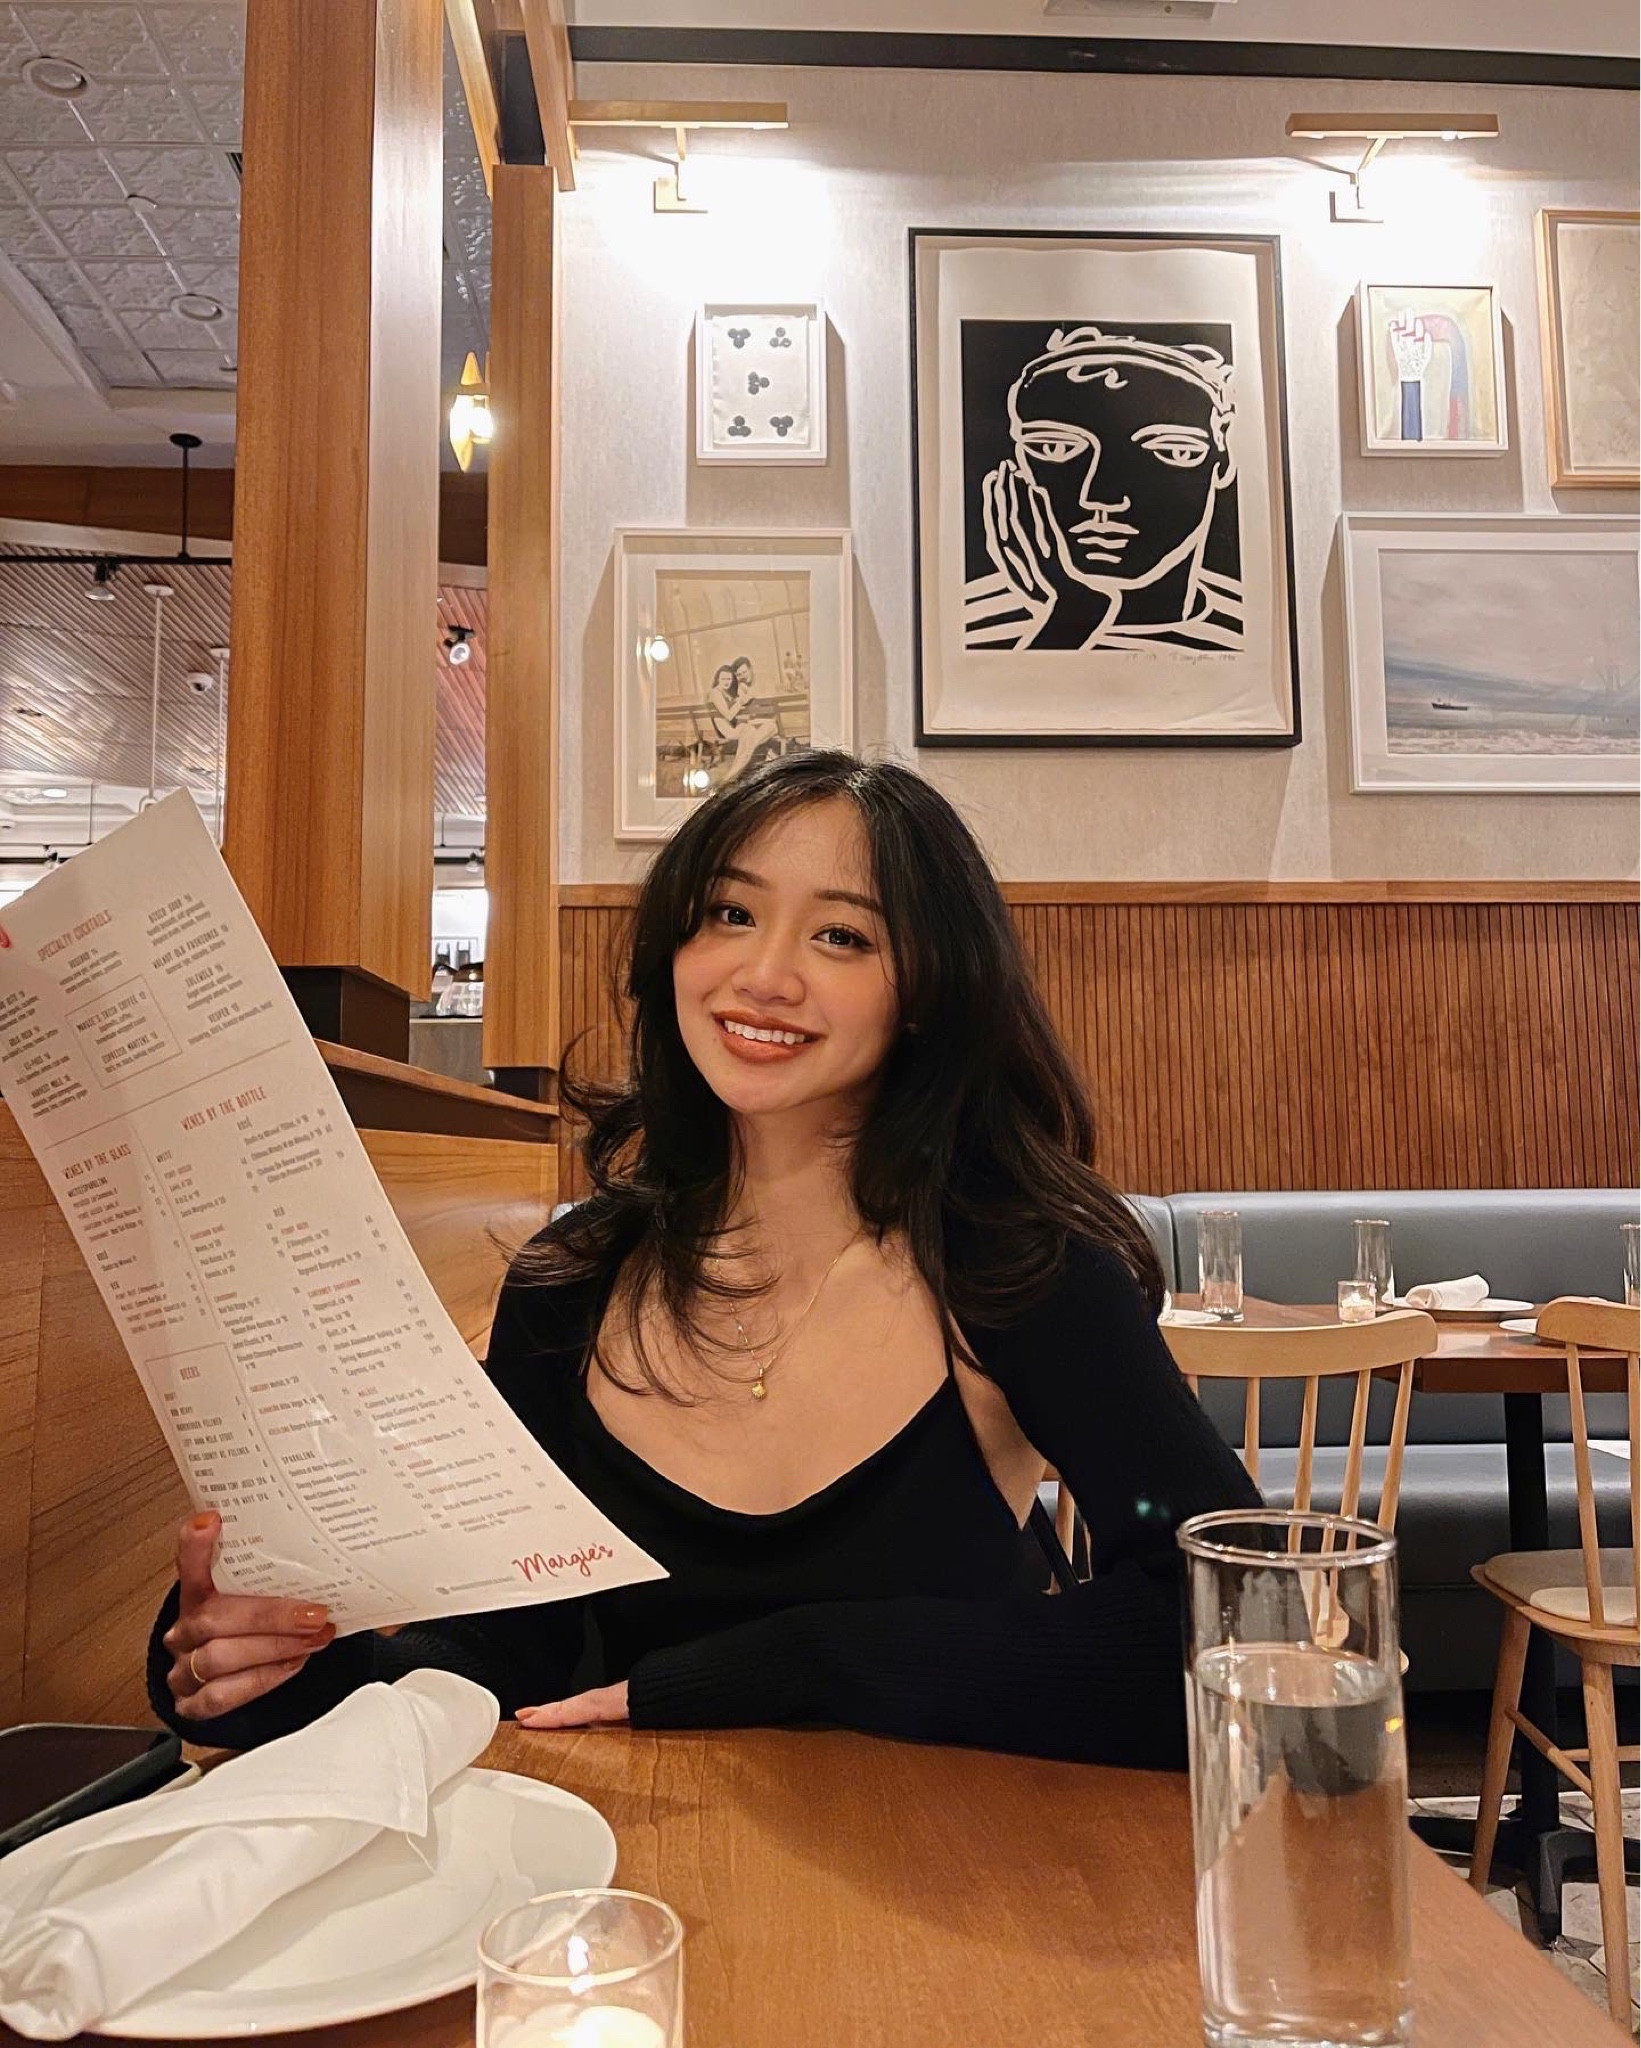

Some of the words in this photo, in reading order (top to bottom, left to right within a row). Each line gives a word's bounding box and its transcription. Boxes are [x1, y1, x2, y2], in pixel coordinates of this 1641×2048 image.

[37, 932, 73, 961] SPECIALTY
[72, 909, 111, 940] COCKTAILS
[151, 952, 173, 968] WALNUT
[173, 945, 186, 958] OLD
[186, 927, 218, 951] FASHIONED
[76, 1014, 101, 1031] MARGIE'S
[118, 995, 138, 1010] COFFEE
[127, 1034, 149, 1050] MARTINI
[181, 1110, 206, 1130] WINES
[205, 1106, 217, 1120] BY
[219, 1098, 234, 1114] THE
[236, 1085, 266, 1108] BOTTLE
[62, 1161, 83, 1179] WINES
[84, 1157, 95, 1171] BY
[94, 1151, 108, 1166] THE
[107, 1143, 131, 1161] GLASS
[179, 1365, 199, 1380] BEERS
[281, 1449, 315, 1464] SPARKLING
[512, 1543, 612, 1582] Margie's
